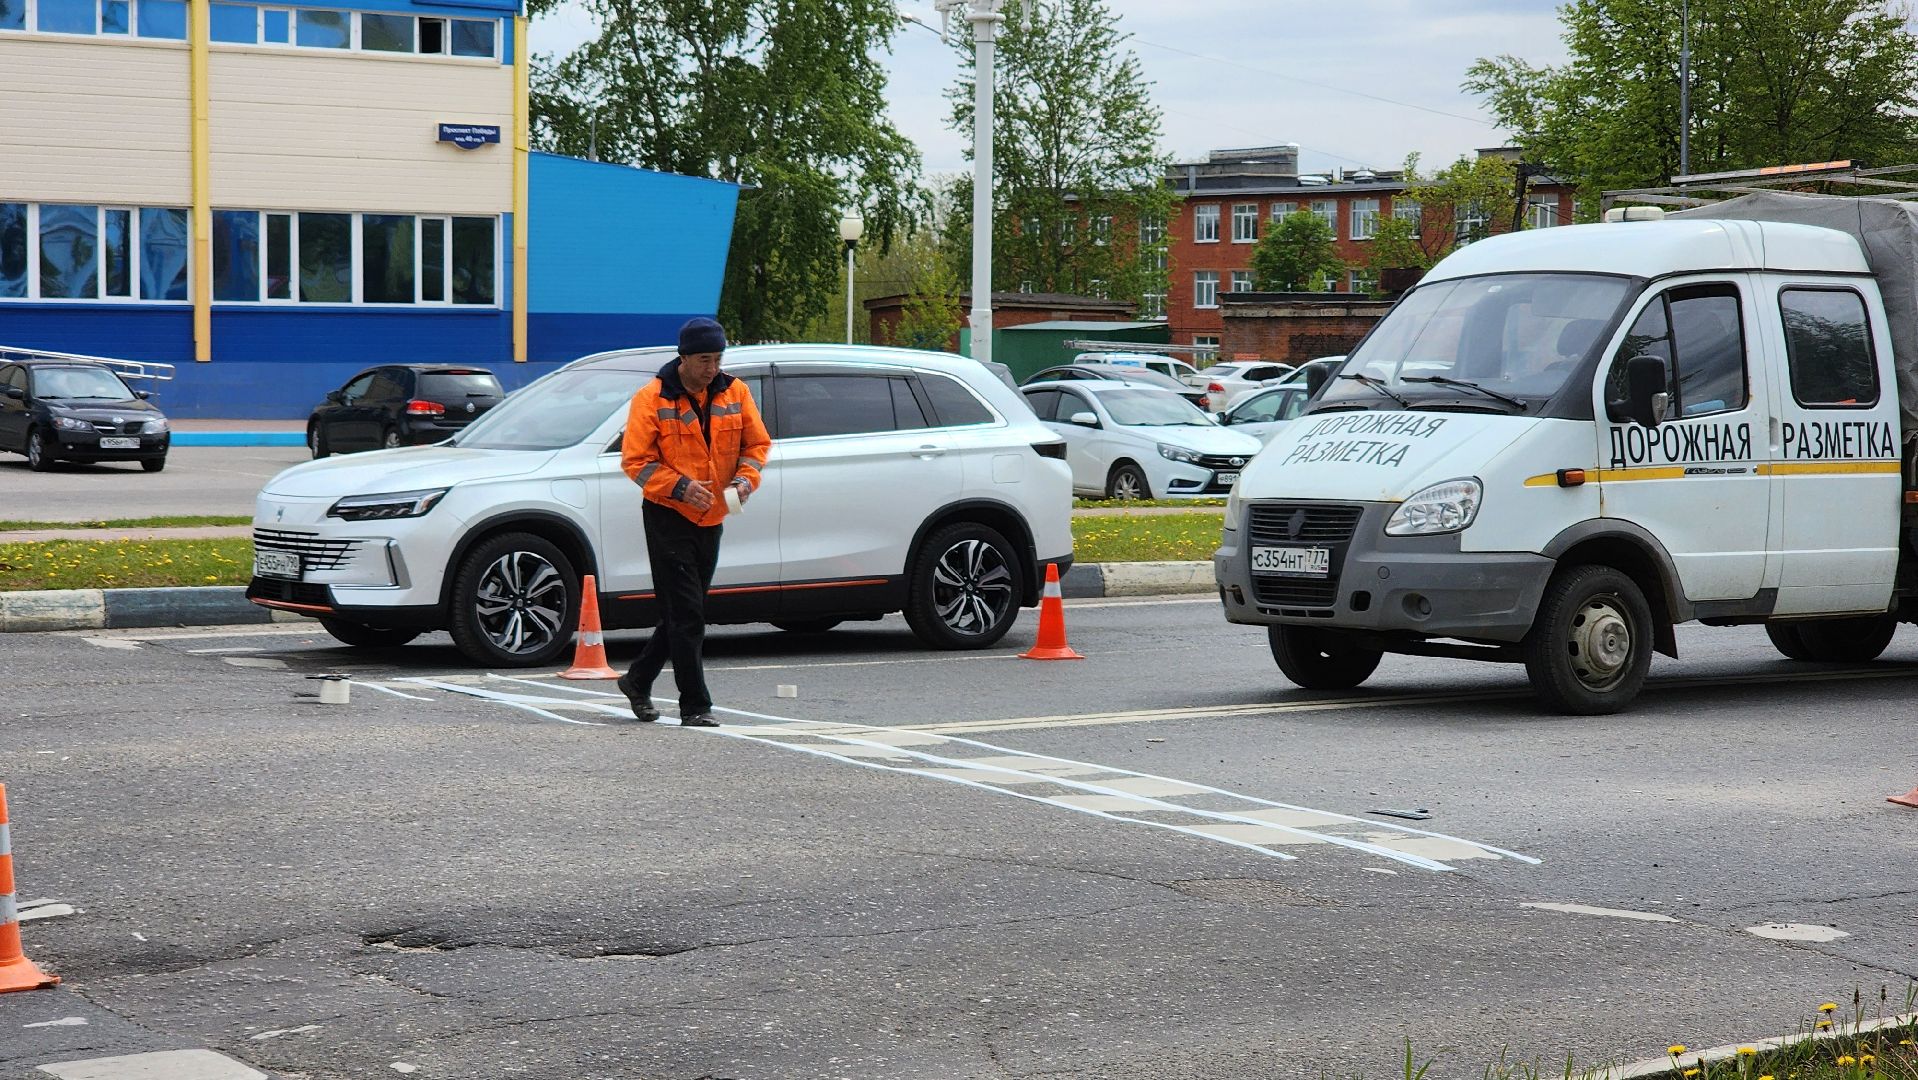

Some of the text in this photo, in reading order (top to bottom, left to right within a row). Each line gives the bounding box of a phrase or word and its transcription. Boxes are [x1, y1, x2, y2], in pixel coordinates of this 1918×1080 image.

[443, 126, 496, 135] Проспект Победы
[1298, 413, 1448, 442] ДОРОЖНАЯ
[1282, 440, 1411, 468] РАЗМЕТКА
[1610, 421, 1895, 471] ДОРОЖНАЯ РАЗМЕТКА
